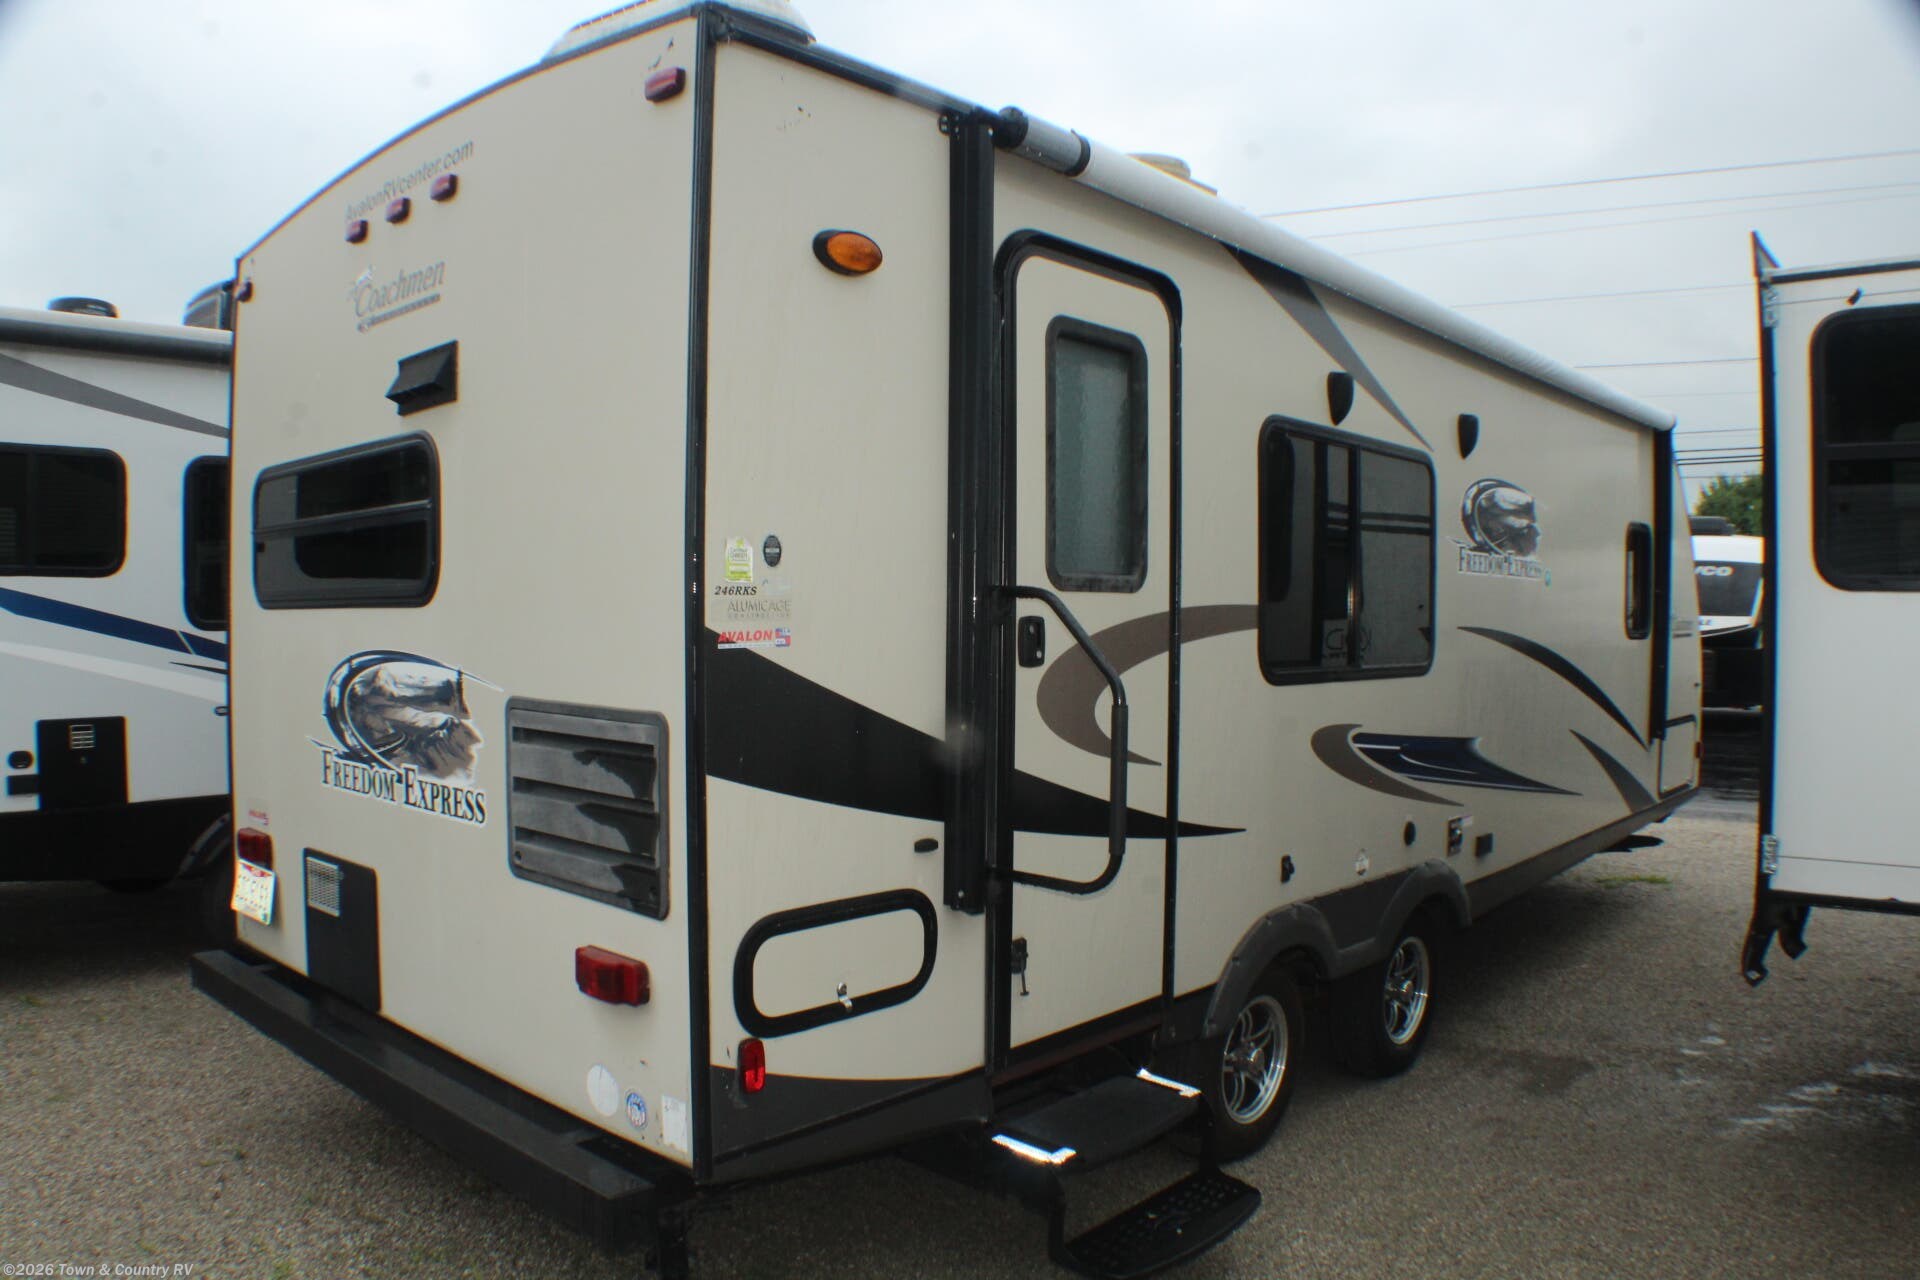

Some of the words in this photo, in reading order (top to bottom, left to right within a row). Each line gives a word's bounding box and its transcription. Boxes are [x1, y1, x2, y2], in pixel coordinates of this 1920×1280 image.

[354, 261, 445, 318] Coachmen
[714, 586, 758, 596] 246RKS
[727, 600, 791, 613] ALUMICAGE
[718, 629, 773, 643] AVALON
[322, 750, 397, 803] FREEDOM
[403, 767, 487, 824] EXPRESS
